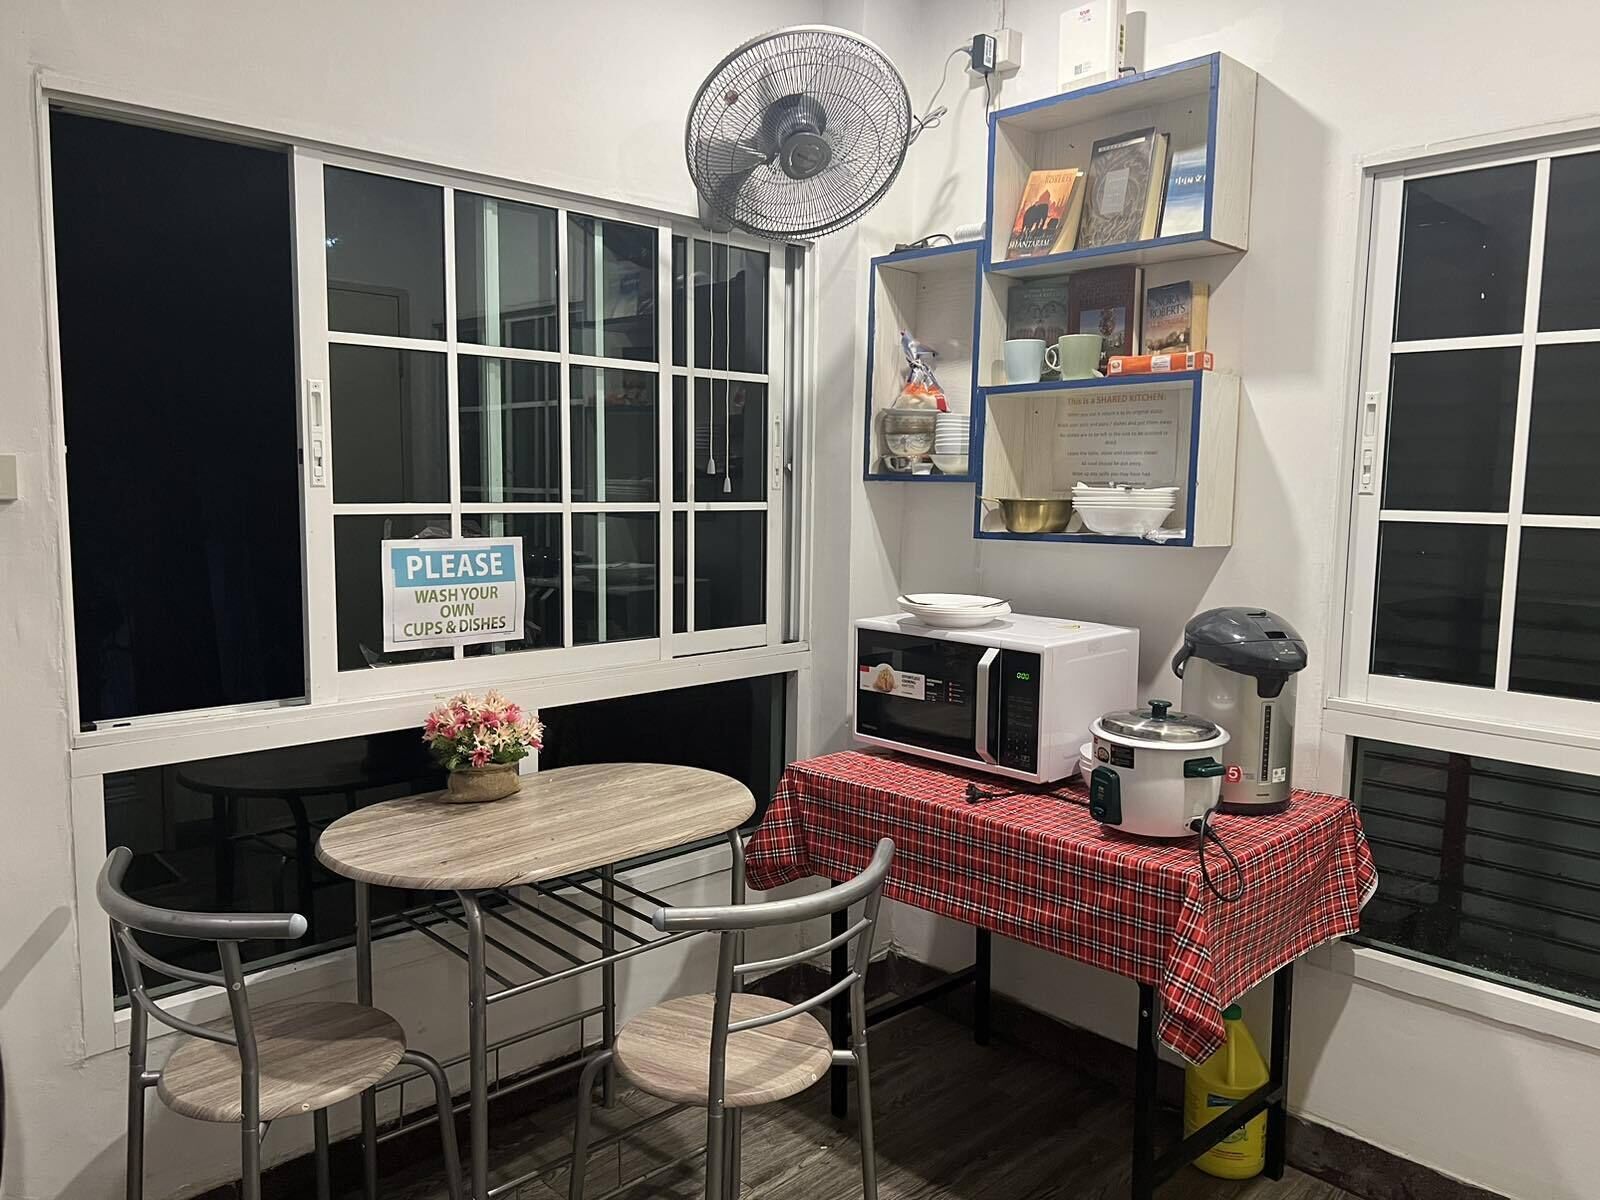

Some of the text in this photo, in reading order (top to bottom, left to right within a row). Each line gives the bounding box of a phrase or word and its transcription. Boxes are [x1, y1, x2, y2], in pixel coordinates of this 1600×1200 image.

[1008, 239, 1050, 249] SHANTARAM
[1156, 294, 1181, 306] NORA
[1151, 304, 1186, 319] ROBERTS
[1096, 394, 1127, 405] SHARED
[406, 552, 504, 580] PLEASE
[415, 585, 498, 604] WASH YOUR
[440, 603, 475, 618] OWN
[403, 616, 506, 637] CUPS & DISHES
[1228, 766, 1238, 779] 5
